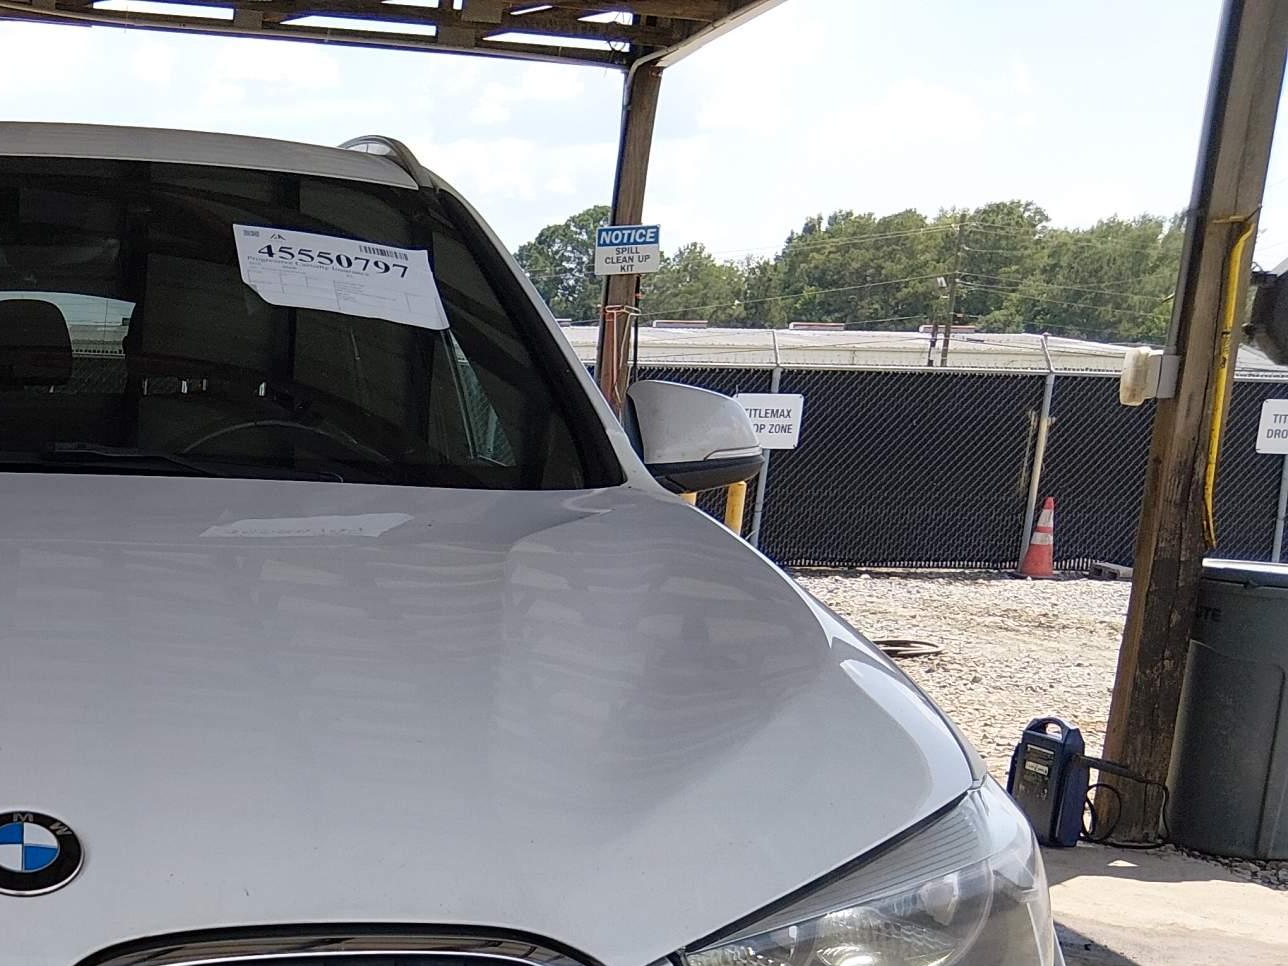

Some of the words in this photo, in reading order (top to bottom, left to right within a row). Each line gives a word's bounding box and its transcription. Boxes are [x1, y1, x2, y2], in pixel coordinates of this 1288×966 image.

[599, 228, 657, 244] NOTICE
[615, 246, 641, 256] SPILL
[257, 244, 409, 279] 45550797
[604, 256, 634, 265] CLEAN
[637, 254, 651, 263] UP
[620, 264, 635, 273] KIT
[768, 423, 793, 434] ZONE
